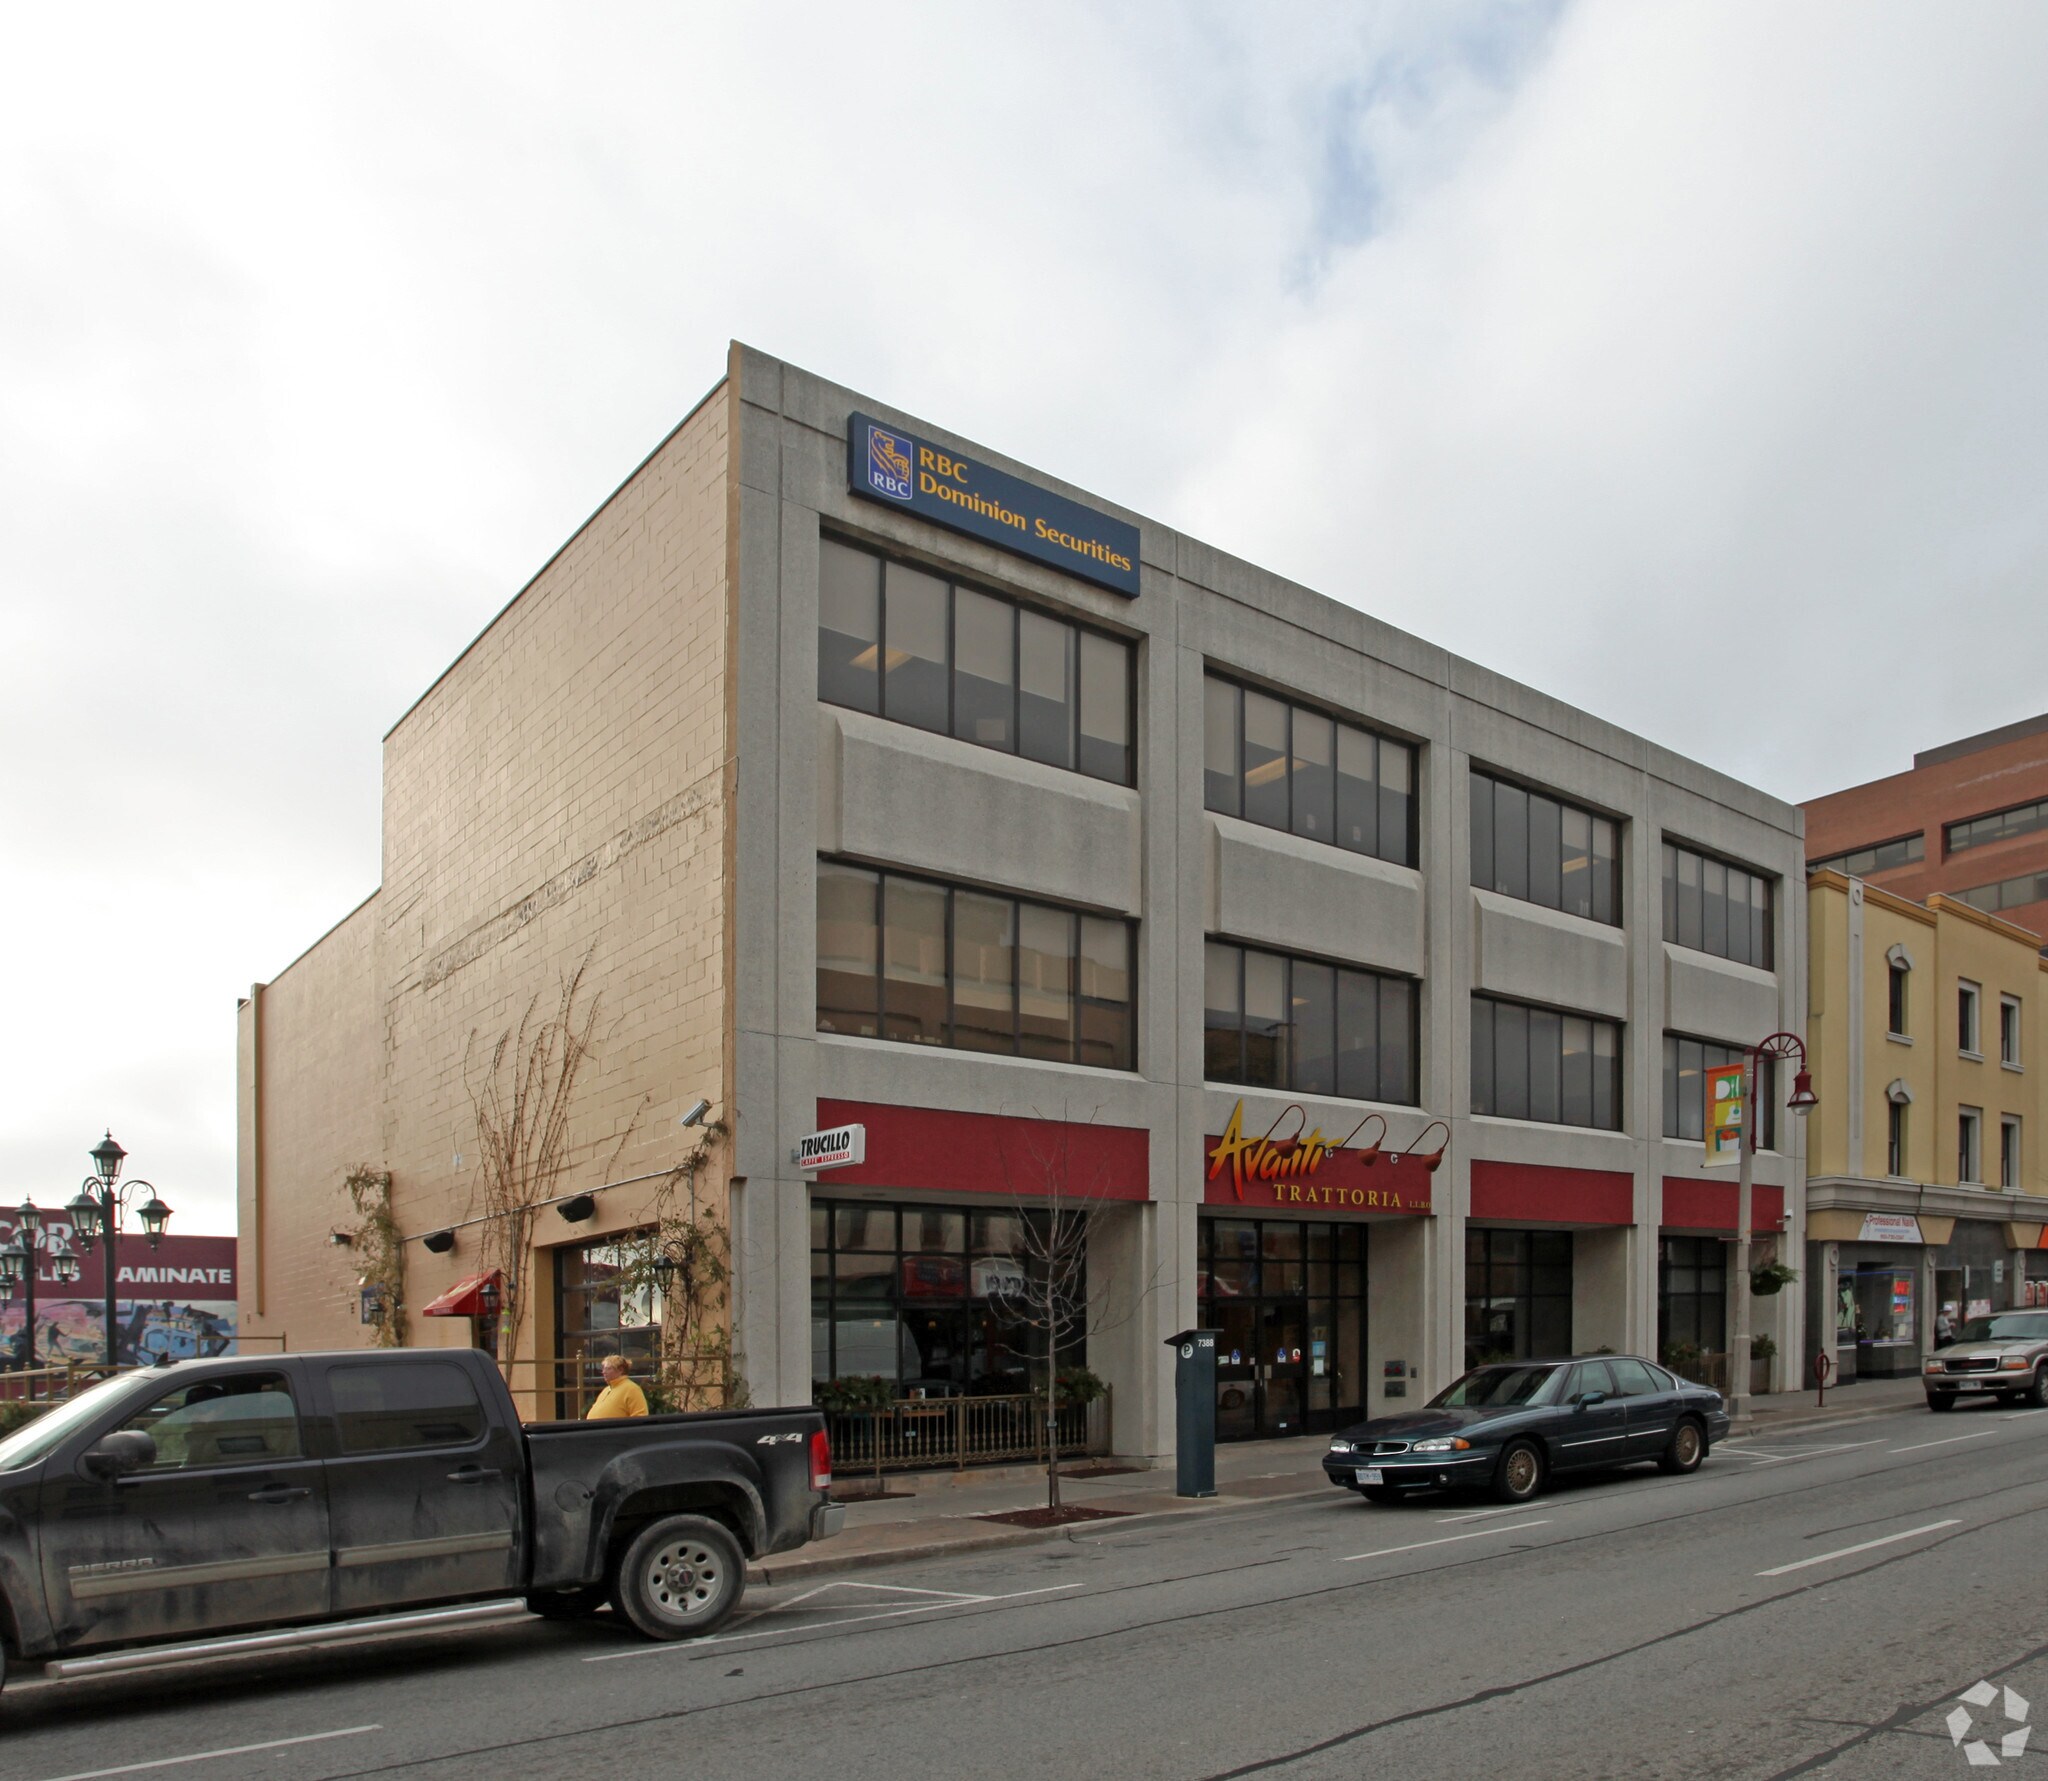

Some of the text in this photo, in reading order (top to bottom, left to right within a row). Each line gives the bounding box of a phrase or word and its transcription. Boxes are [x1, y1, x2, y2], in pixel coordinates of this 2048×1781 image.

[919, 446, 968, 484] RBC
[873, 471, 909, 497] RBC
[919, 472, 1132, 572] Dominion Securities
[801, 1131, 851, 1157] TRUCILLO
[1208, 1097, 1344, 1201] Avanti
[1273, 1183, 1402, 1208] TRATTORIA
[115, 1266, 232, 1284] AMINATE
[1198, 1338, 1214, 1347] 7388
